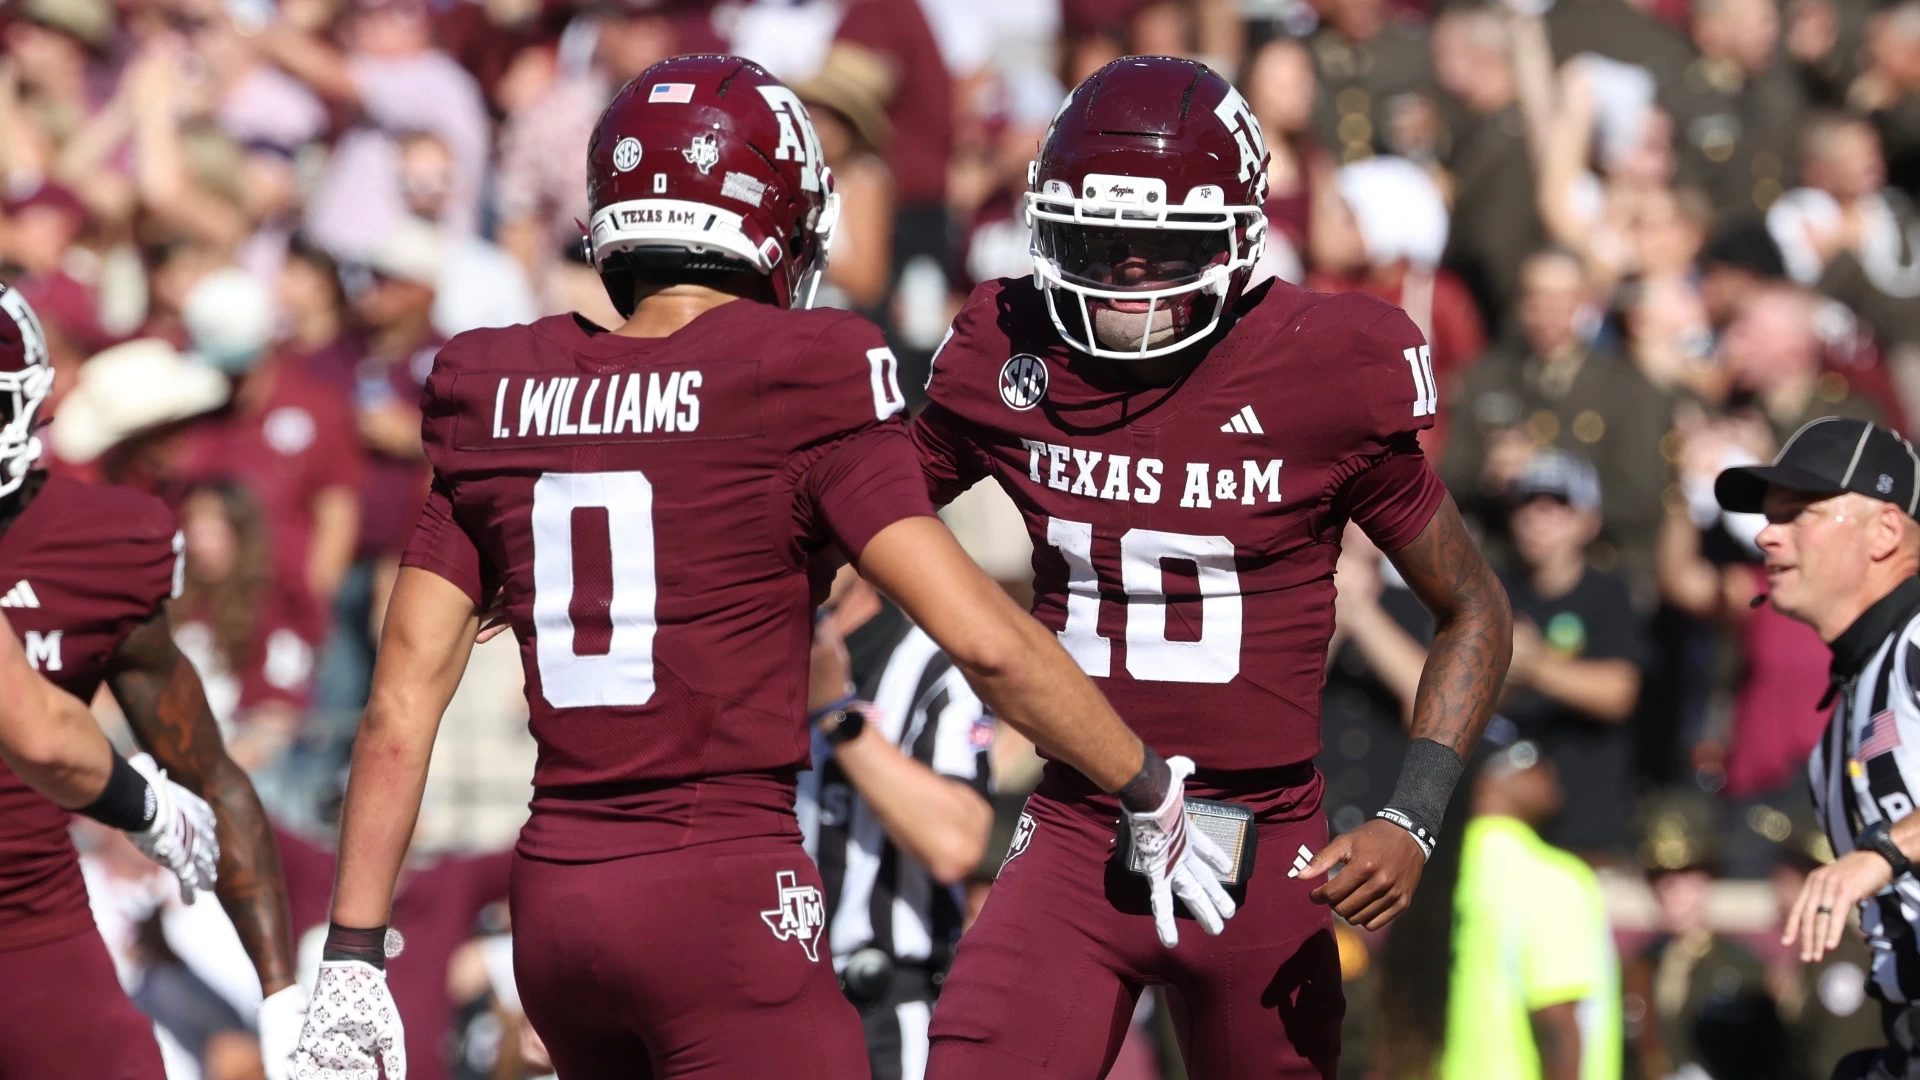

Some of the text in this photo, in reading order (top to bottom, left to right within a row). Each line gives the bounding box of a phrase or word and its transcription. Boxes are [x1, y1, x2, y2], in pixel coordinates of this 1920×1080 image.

[616, 140, 639, 168] SEC
[653, 172, 667, 194] 0
[621, 209, 696, 225] TEXAS A&M
[1109, 184, 1135, 198] Aggies
[517, 370, 703, 437] WILLIAMS
[866, 346, 906, 421] 0
[1002, 357, 1044, 407] SEC
[1403, 345, 1438, 417] 10
[1020, 437, 1284, 509] TEXAS A&M
[531, 470, 658, 709] 0
[1046, 516, 1244, 684] 10
